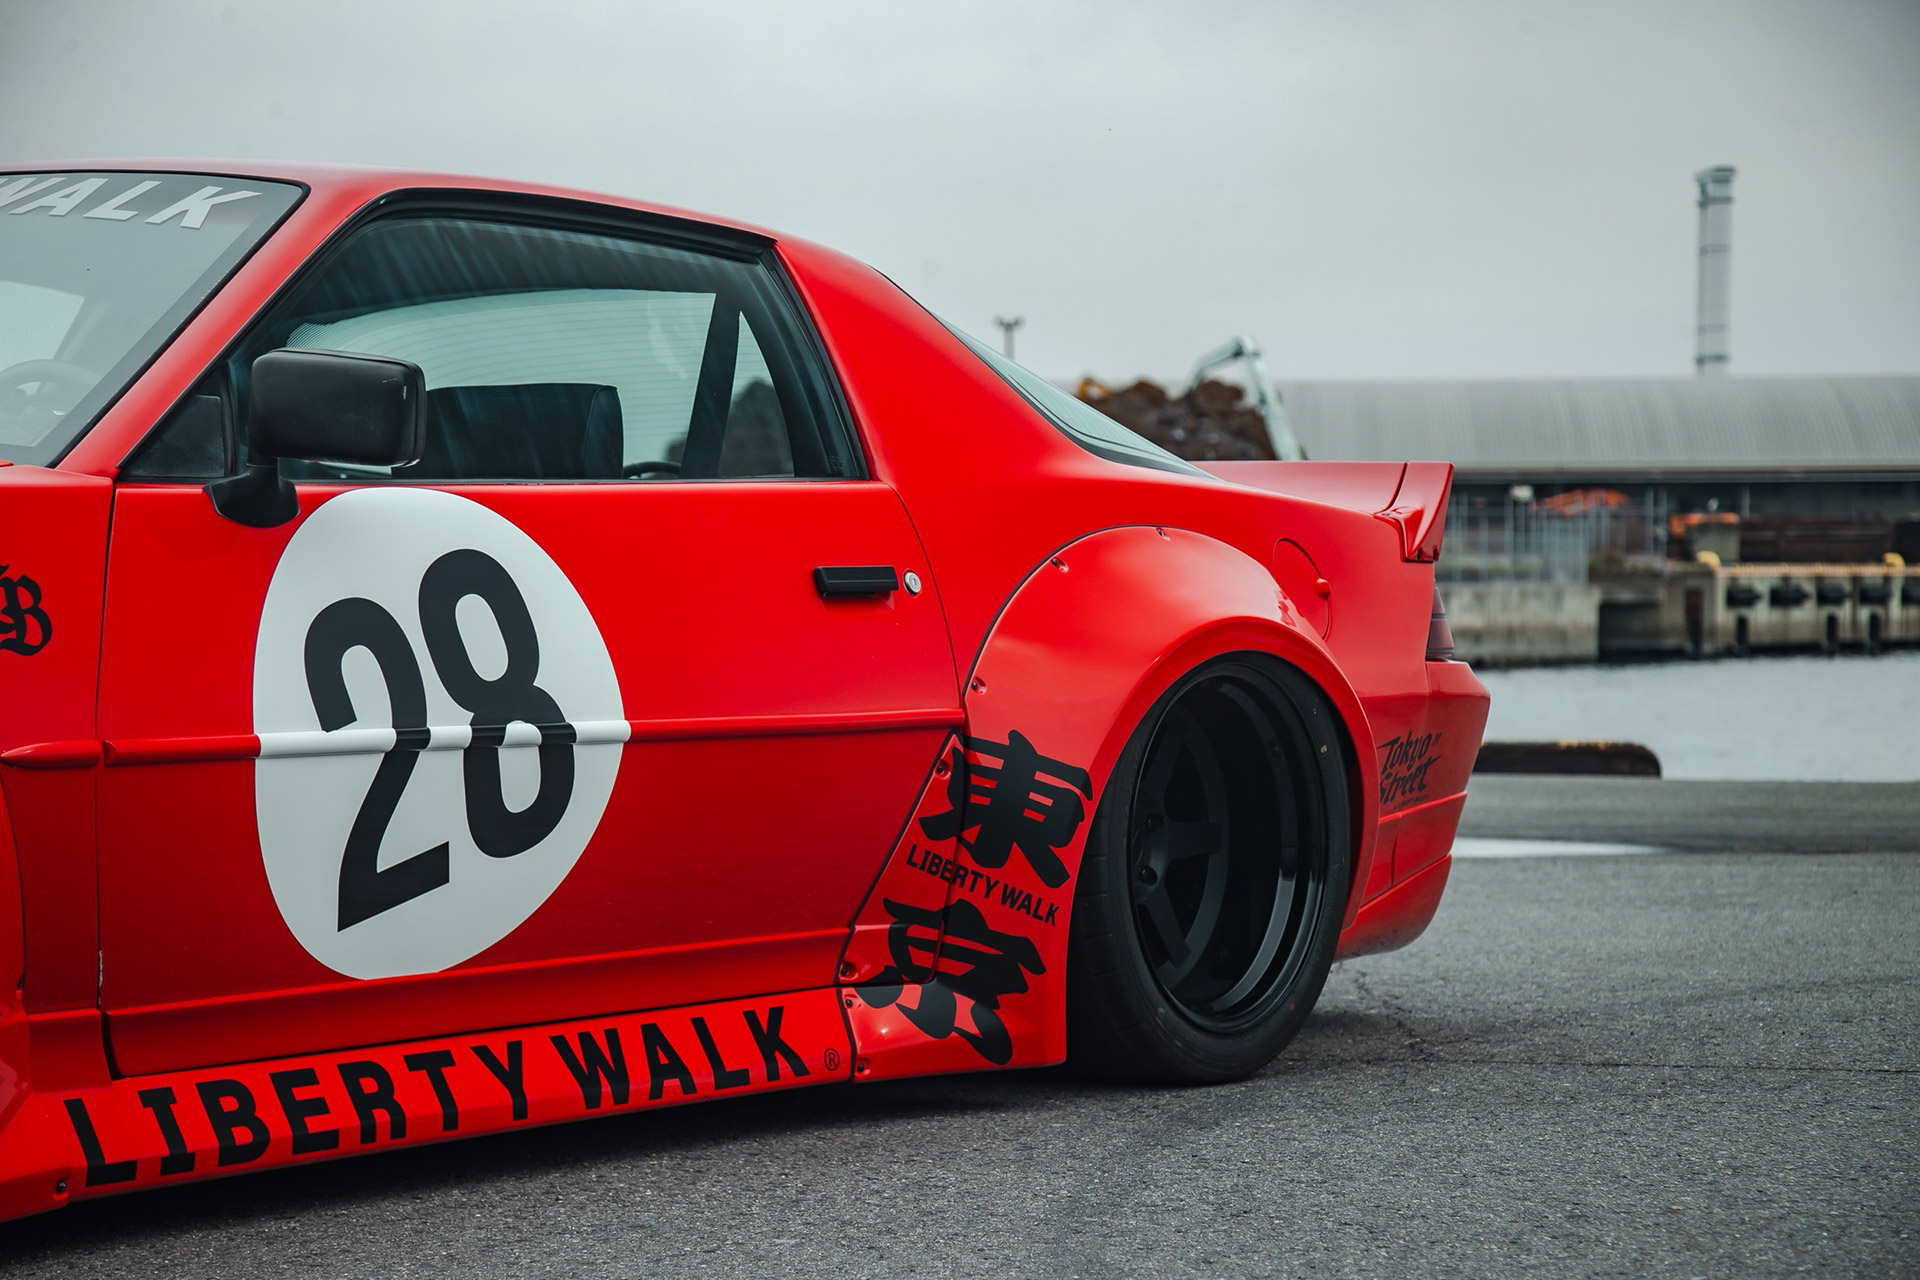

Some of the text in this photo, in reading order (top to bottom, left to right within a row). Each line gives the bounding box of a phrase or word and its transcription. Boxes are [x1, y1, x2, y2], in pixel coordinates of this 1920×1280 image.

[304, 548, 577, 933] 28
[906, 843, 1060, 927] LIBERTY WALK
[64, 1040, 529, 1188] LIBERTY
[549, 1005, 811, 1111] WALK
